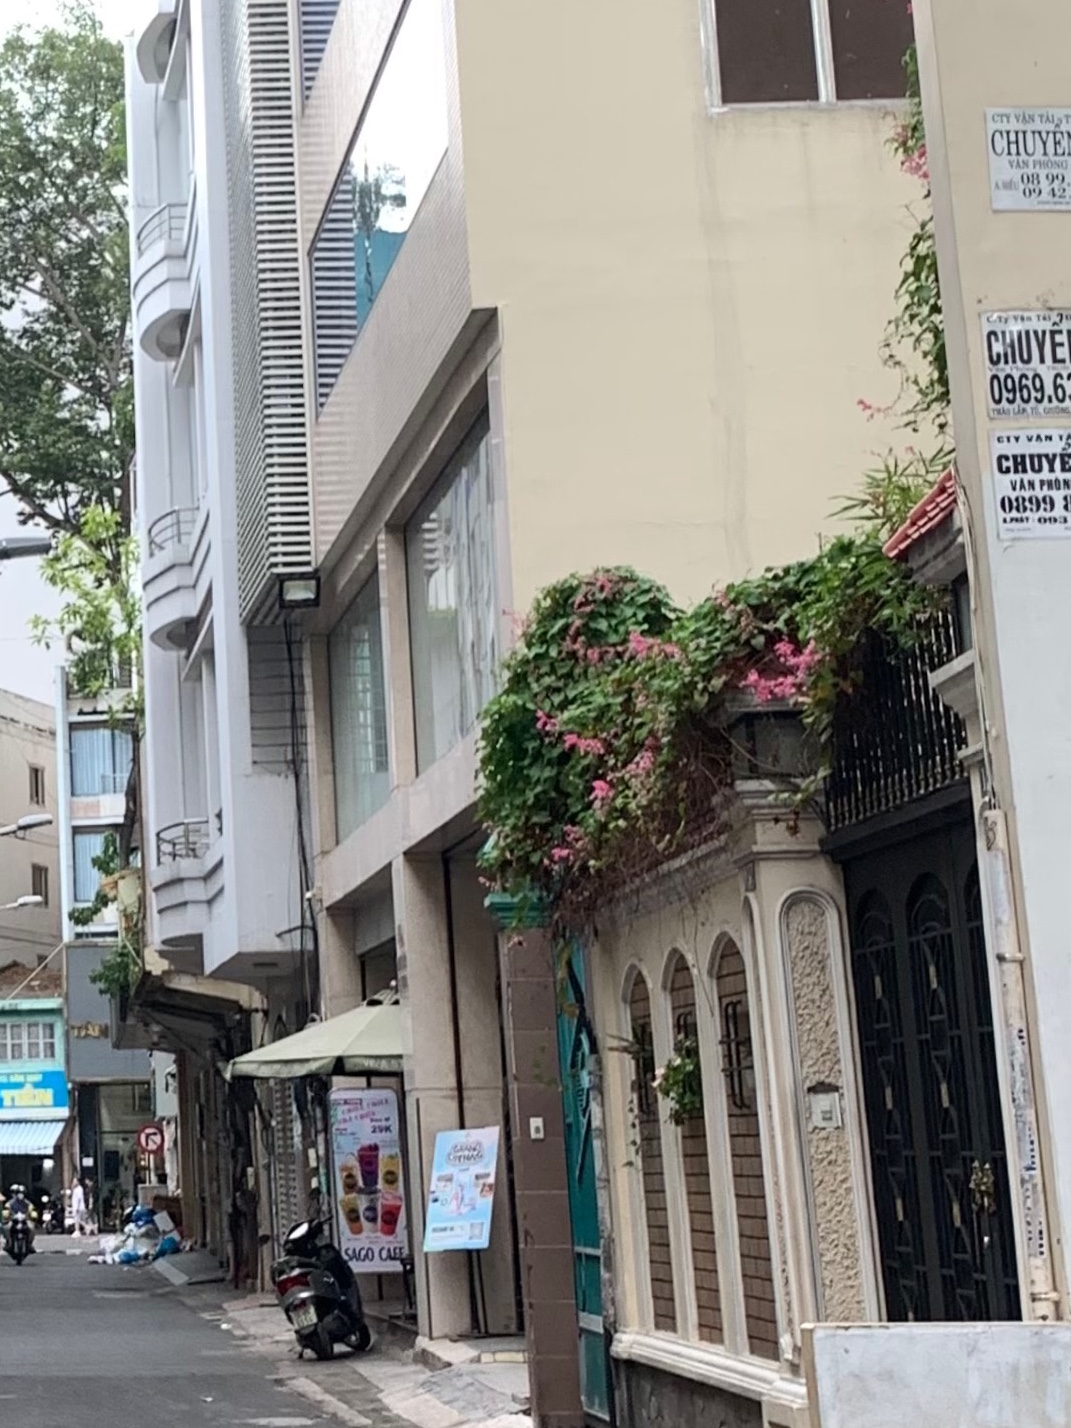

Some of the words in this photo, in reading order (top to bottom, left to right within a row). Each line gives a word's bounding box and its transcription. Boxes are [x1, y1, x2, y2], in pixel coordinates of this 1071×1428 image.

[1021, 172, 1041, 186] 08
[1022, 187, 1042, 199] 09
[996, 435, 1020, 443] CTY
[1000, 494, 1055, 515] 0899
[344, 1246, 375, 1262] SAGO
